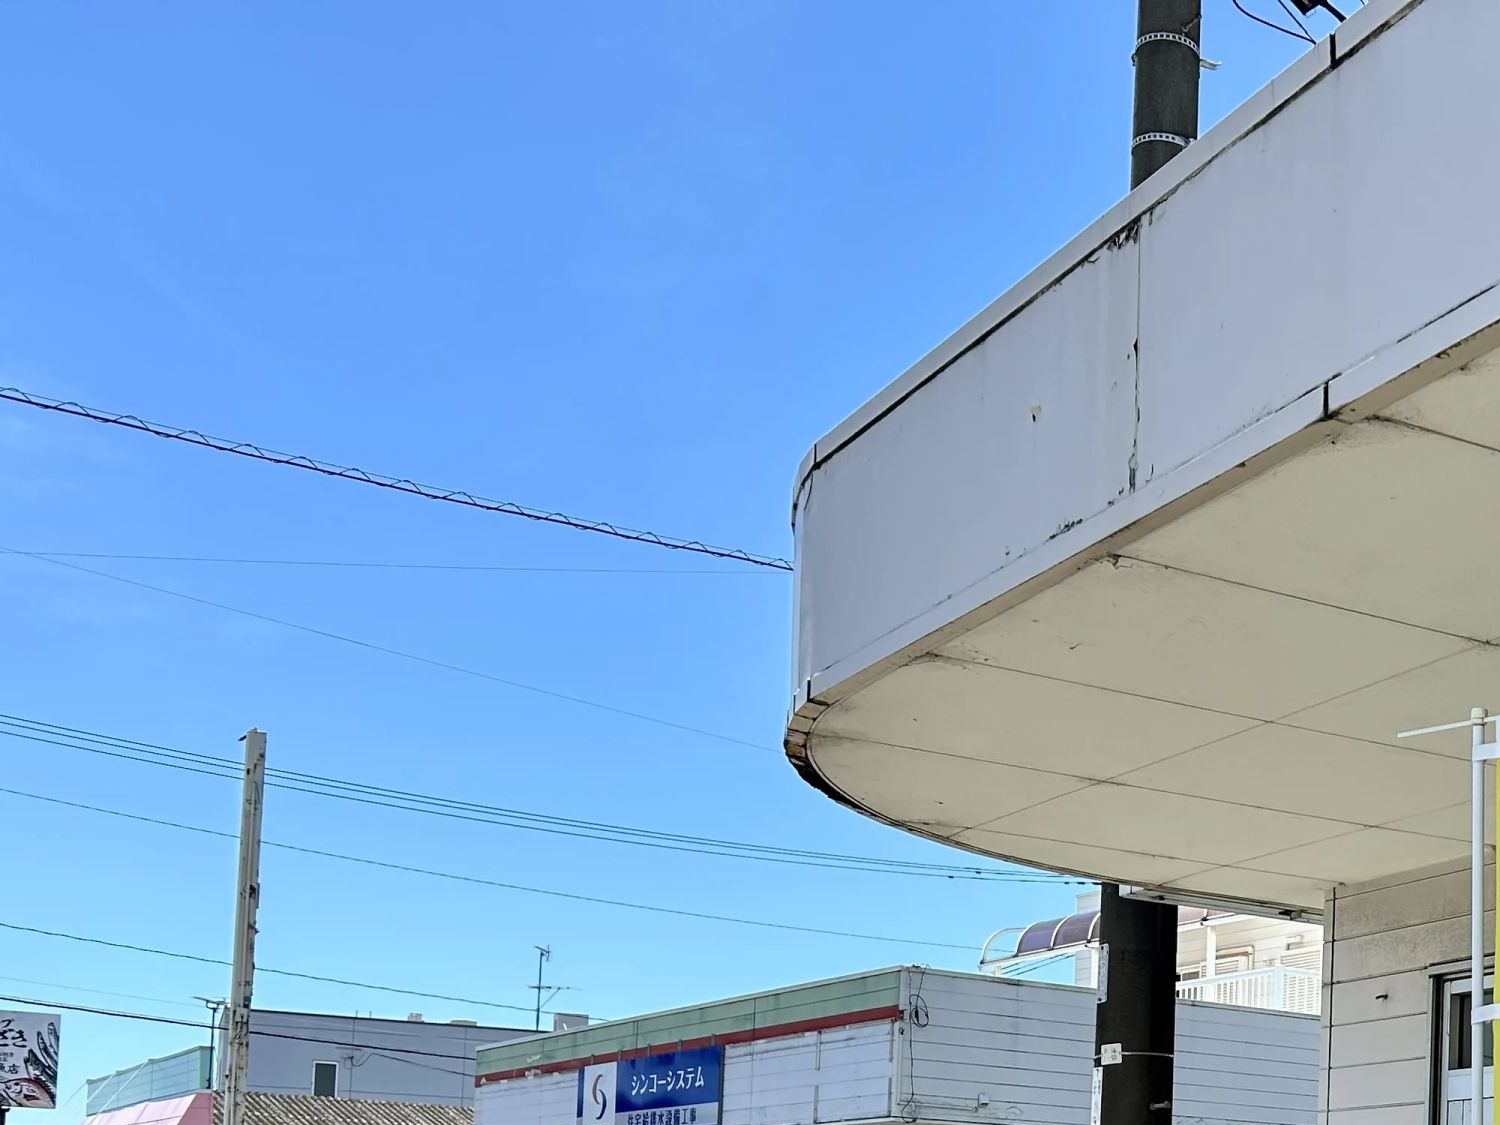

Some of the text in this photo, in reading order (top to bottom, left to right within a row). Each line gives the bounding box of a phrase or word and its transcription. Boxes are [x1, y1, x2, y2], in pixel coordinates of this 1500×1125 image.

[631, 1065, 705, 1096] シンコーシステム
